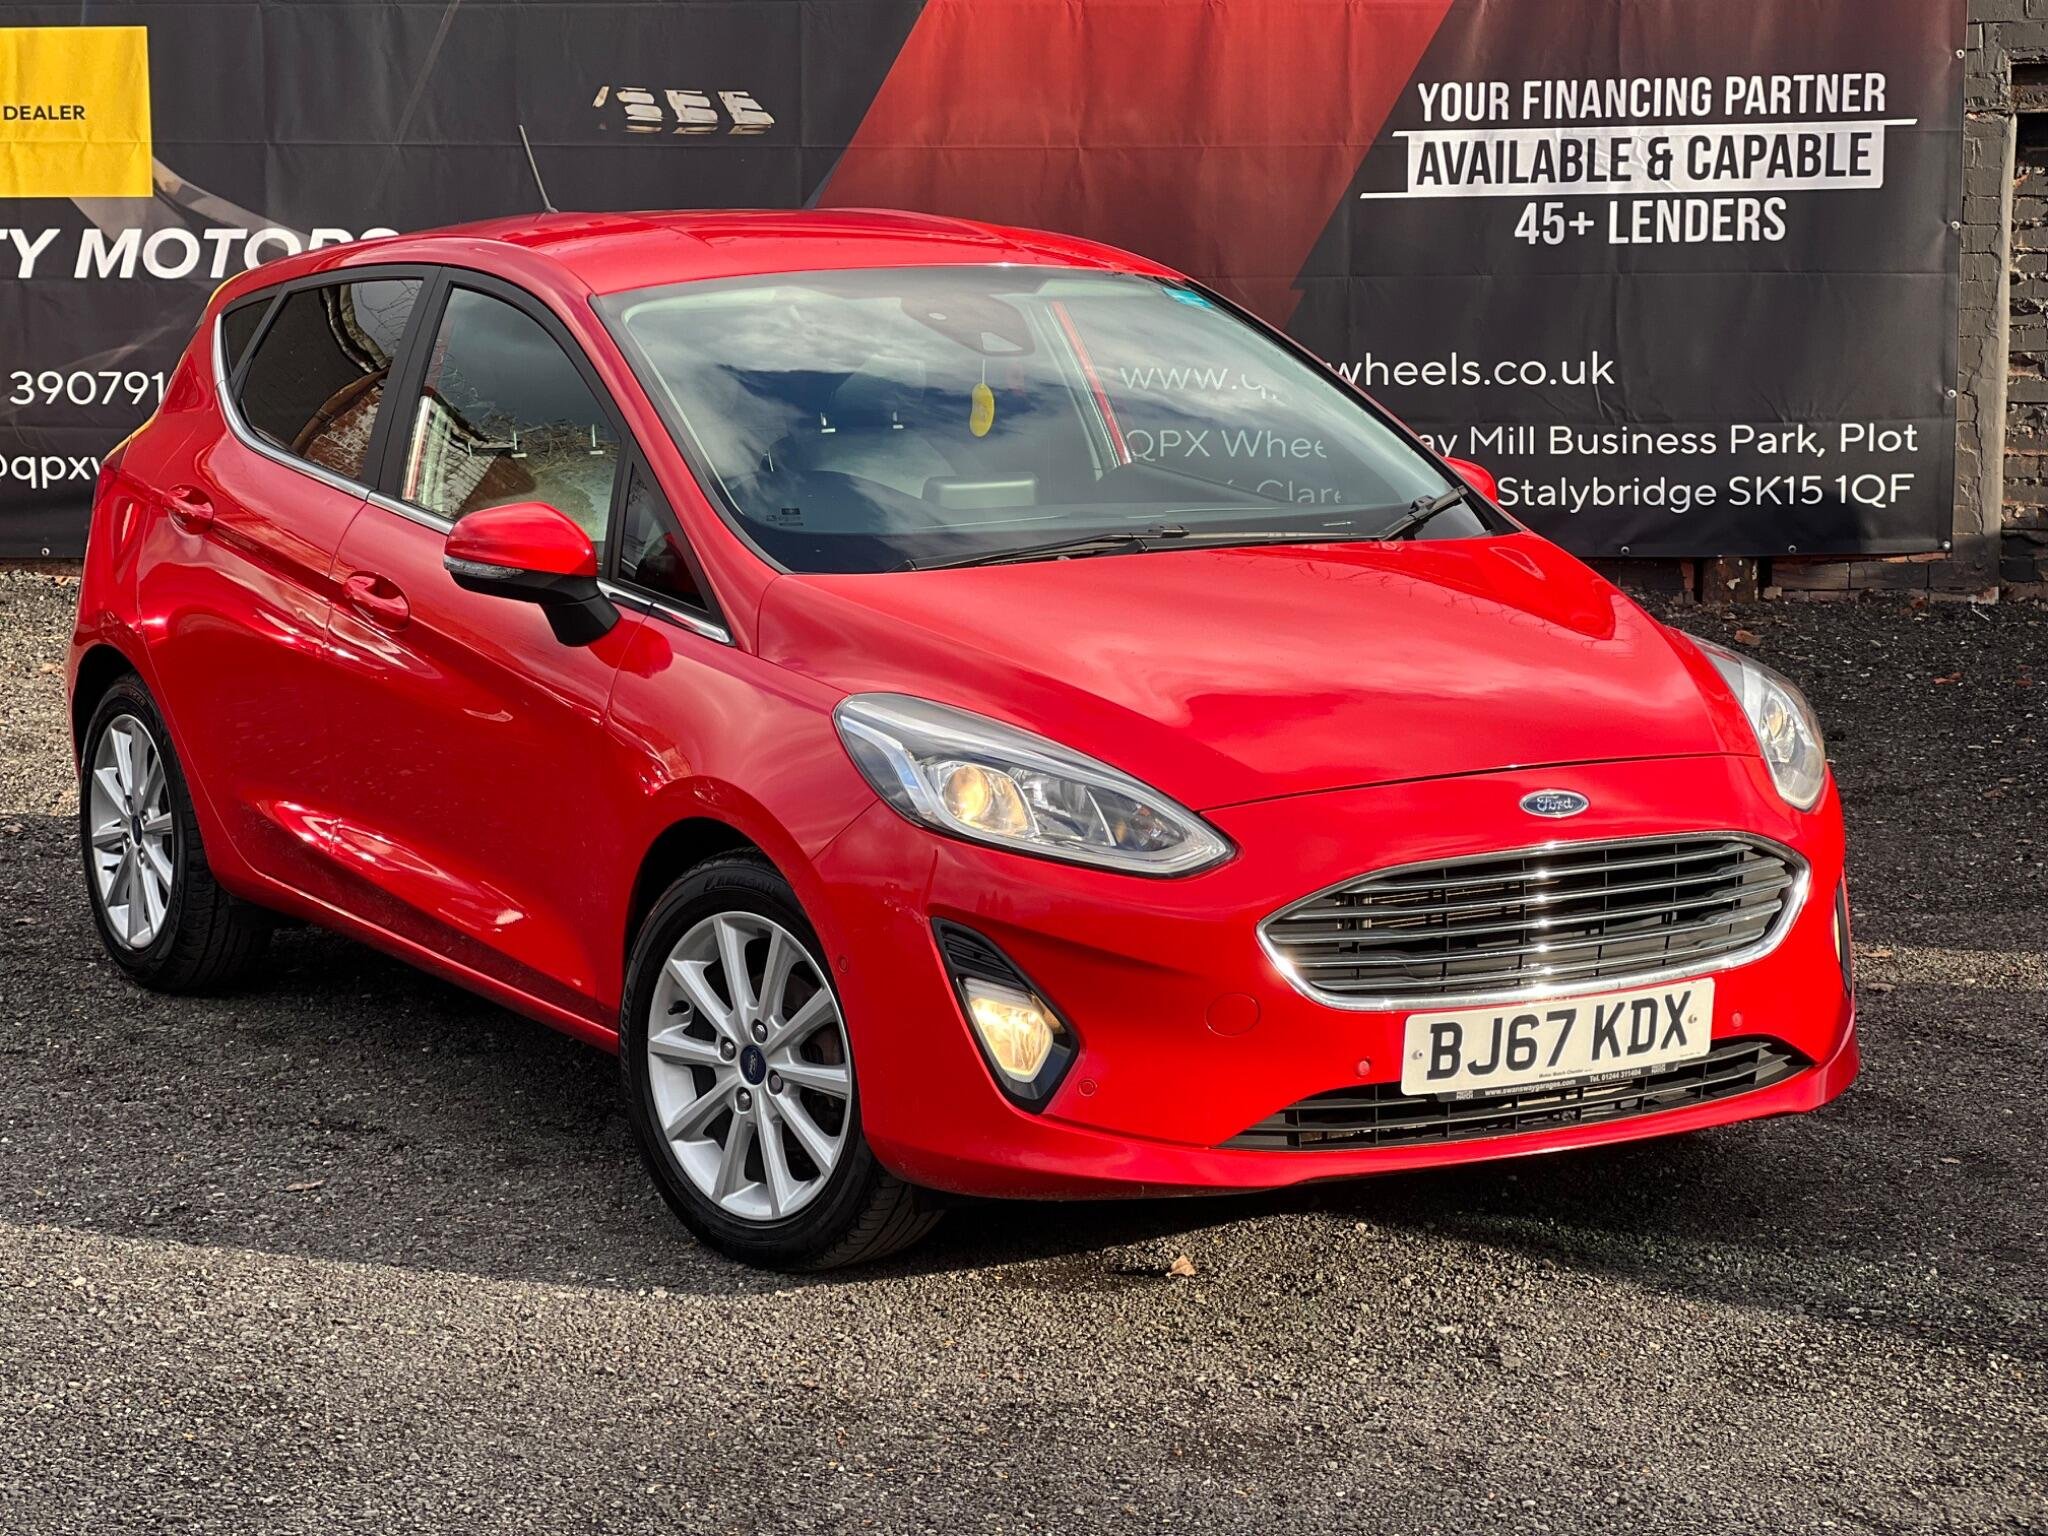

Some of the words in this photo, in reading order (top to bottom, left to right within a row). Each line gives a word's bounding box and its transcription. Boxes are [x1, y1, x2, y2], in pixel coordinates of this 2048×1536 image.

[3, 105, 86, 121] DEALER
[1418, 82, 1509, 121] YOUR
[1523, 76, 1712, 119] FINANCING
[1725, 73, 1887, 116] PARTNER
[1417, 136, 1633, 185] AVAILABLE
[1647, 136, 1673, 179] &
[1687, 132, 1872, 178] CAPABLE
[1514, 202, 1594, 244] 45+
[1608, 197, 1786, 243] LENDERS
[0, 228, 60, 279] Y
[74, 228, 400, 279] MOTO
[9, 371, 164, 405] 390791
[1126, 430, 1210, 462] QPX
[1419, 434, 1458, 457] ay
[1470, 426, 1535, 455] Mill
[1549, 424, 1717, 455] Business
[1731, 424, 1826, 457] Park,
[1841, 422, 1918, 452] Plot
[0, 453, 100, 489] qpx
[1497, 476, 1717, 514] Stalybridge
[1728, 475, 1823, 505] SK15
[1835, 473, 1915, 508] 1QF
[1536, 795, 1573, 812] Ford
[1427, 1007, 1577, 1081] BJ67
[1591, 990, 1692, 1061] KDX
